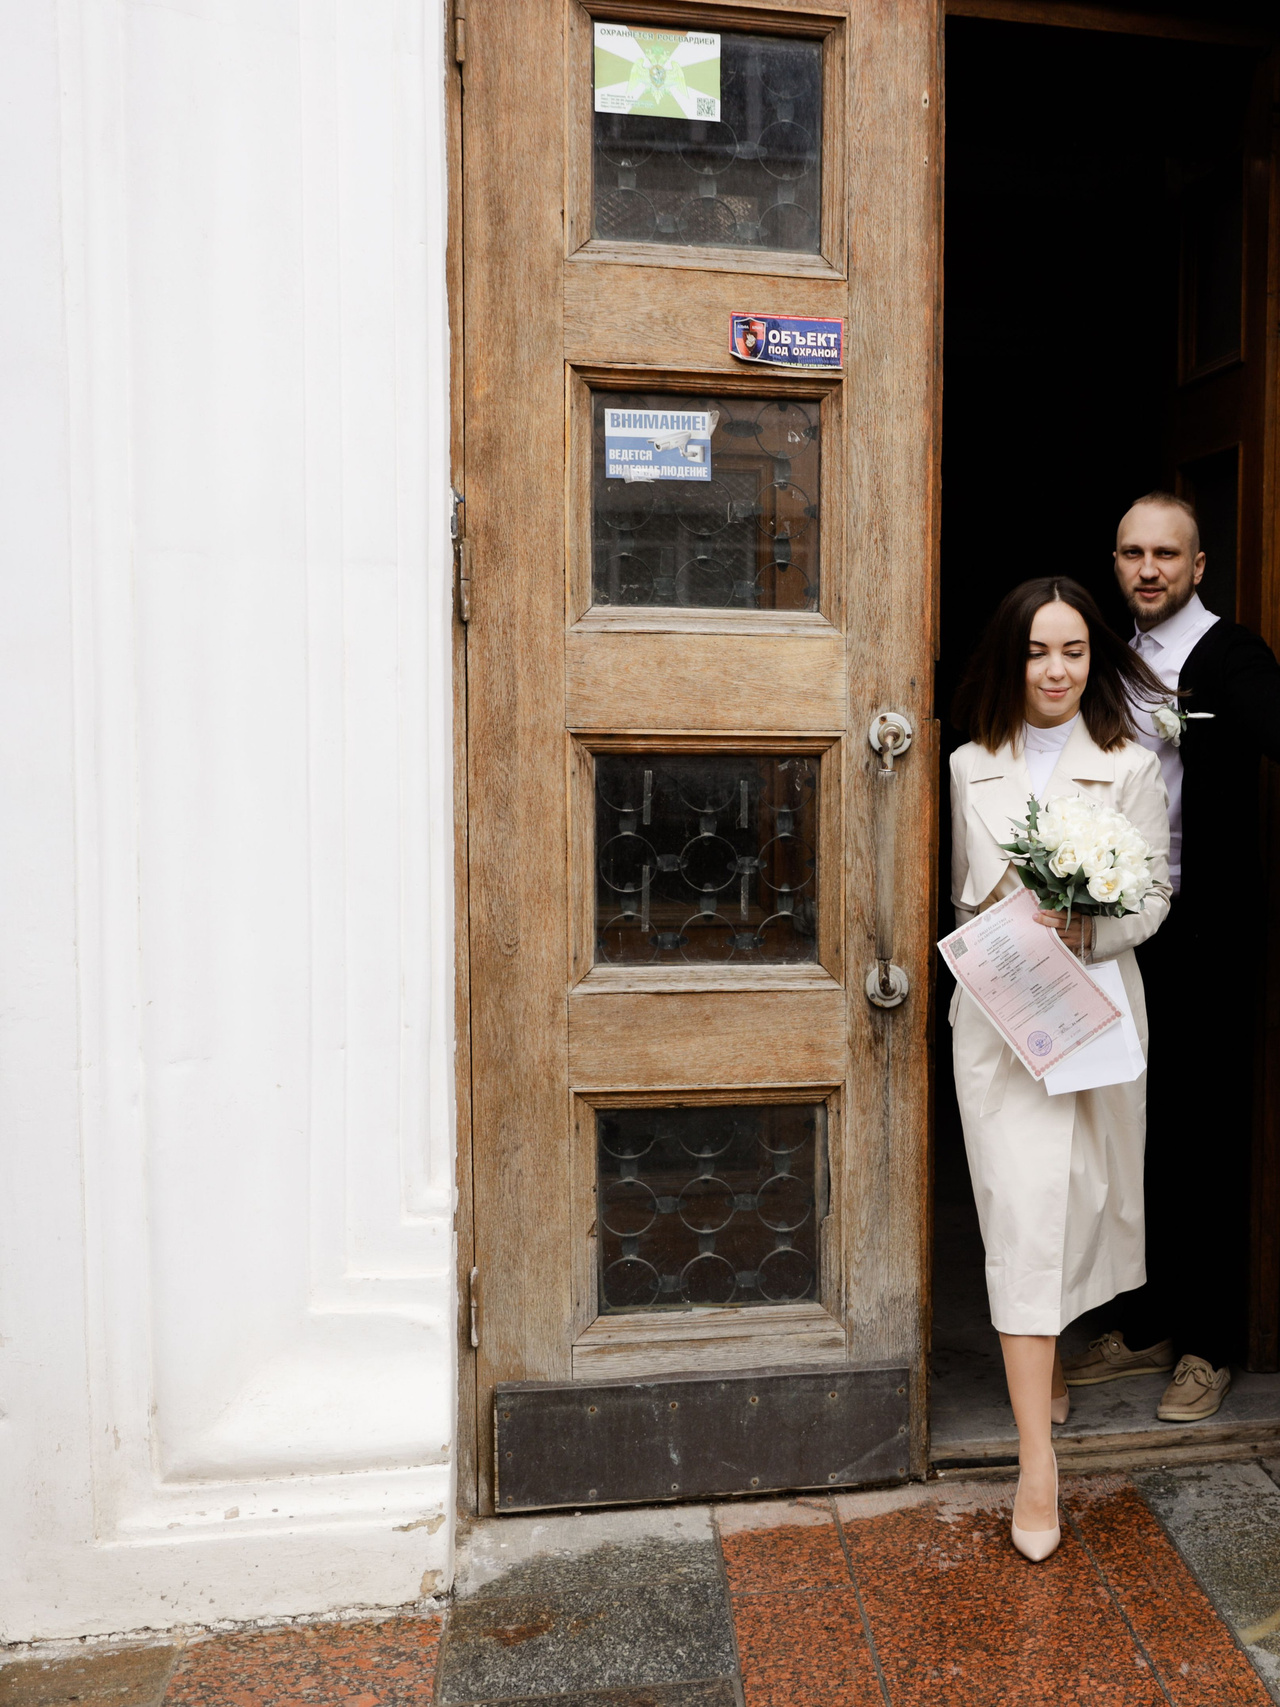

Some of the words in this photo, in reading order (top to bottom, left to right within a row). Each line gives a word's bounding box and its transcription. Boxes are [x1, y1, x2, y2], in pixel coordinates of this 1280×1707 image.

[600, 28, 654, 40] ОХРАНЯЕТСЯ
[657, 32, 715, 46] РОСГВАРДИЕЙ
[768, 329, 838, 347] ОБЪЕКТ
[768, 345, 789, 357] ПОД
[792, 347, 838, 358] ОХРАНОЙ
[610, 412, 706, 431] ВНИМАНИЕ!
[609, 449, 653, 461] ВЕДЕТСЯ
